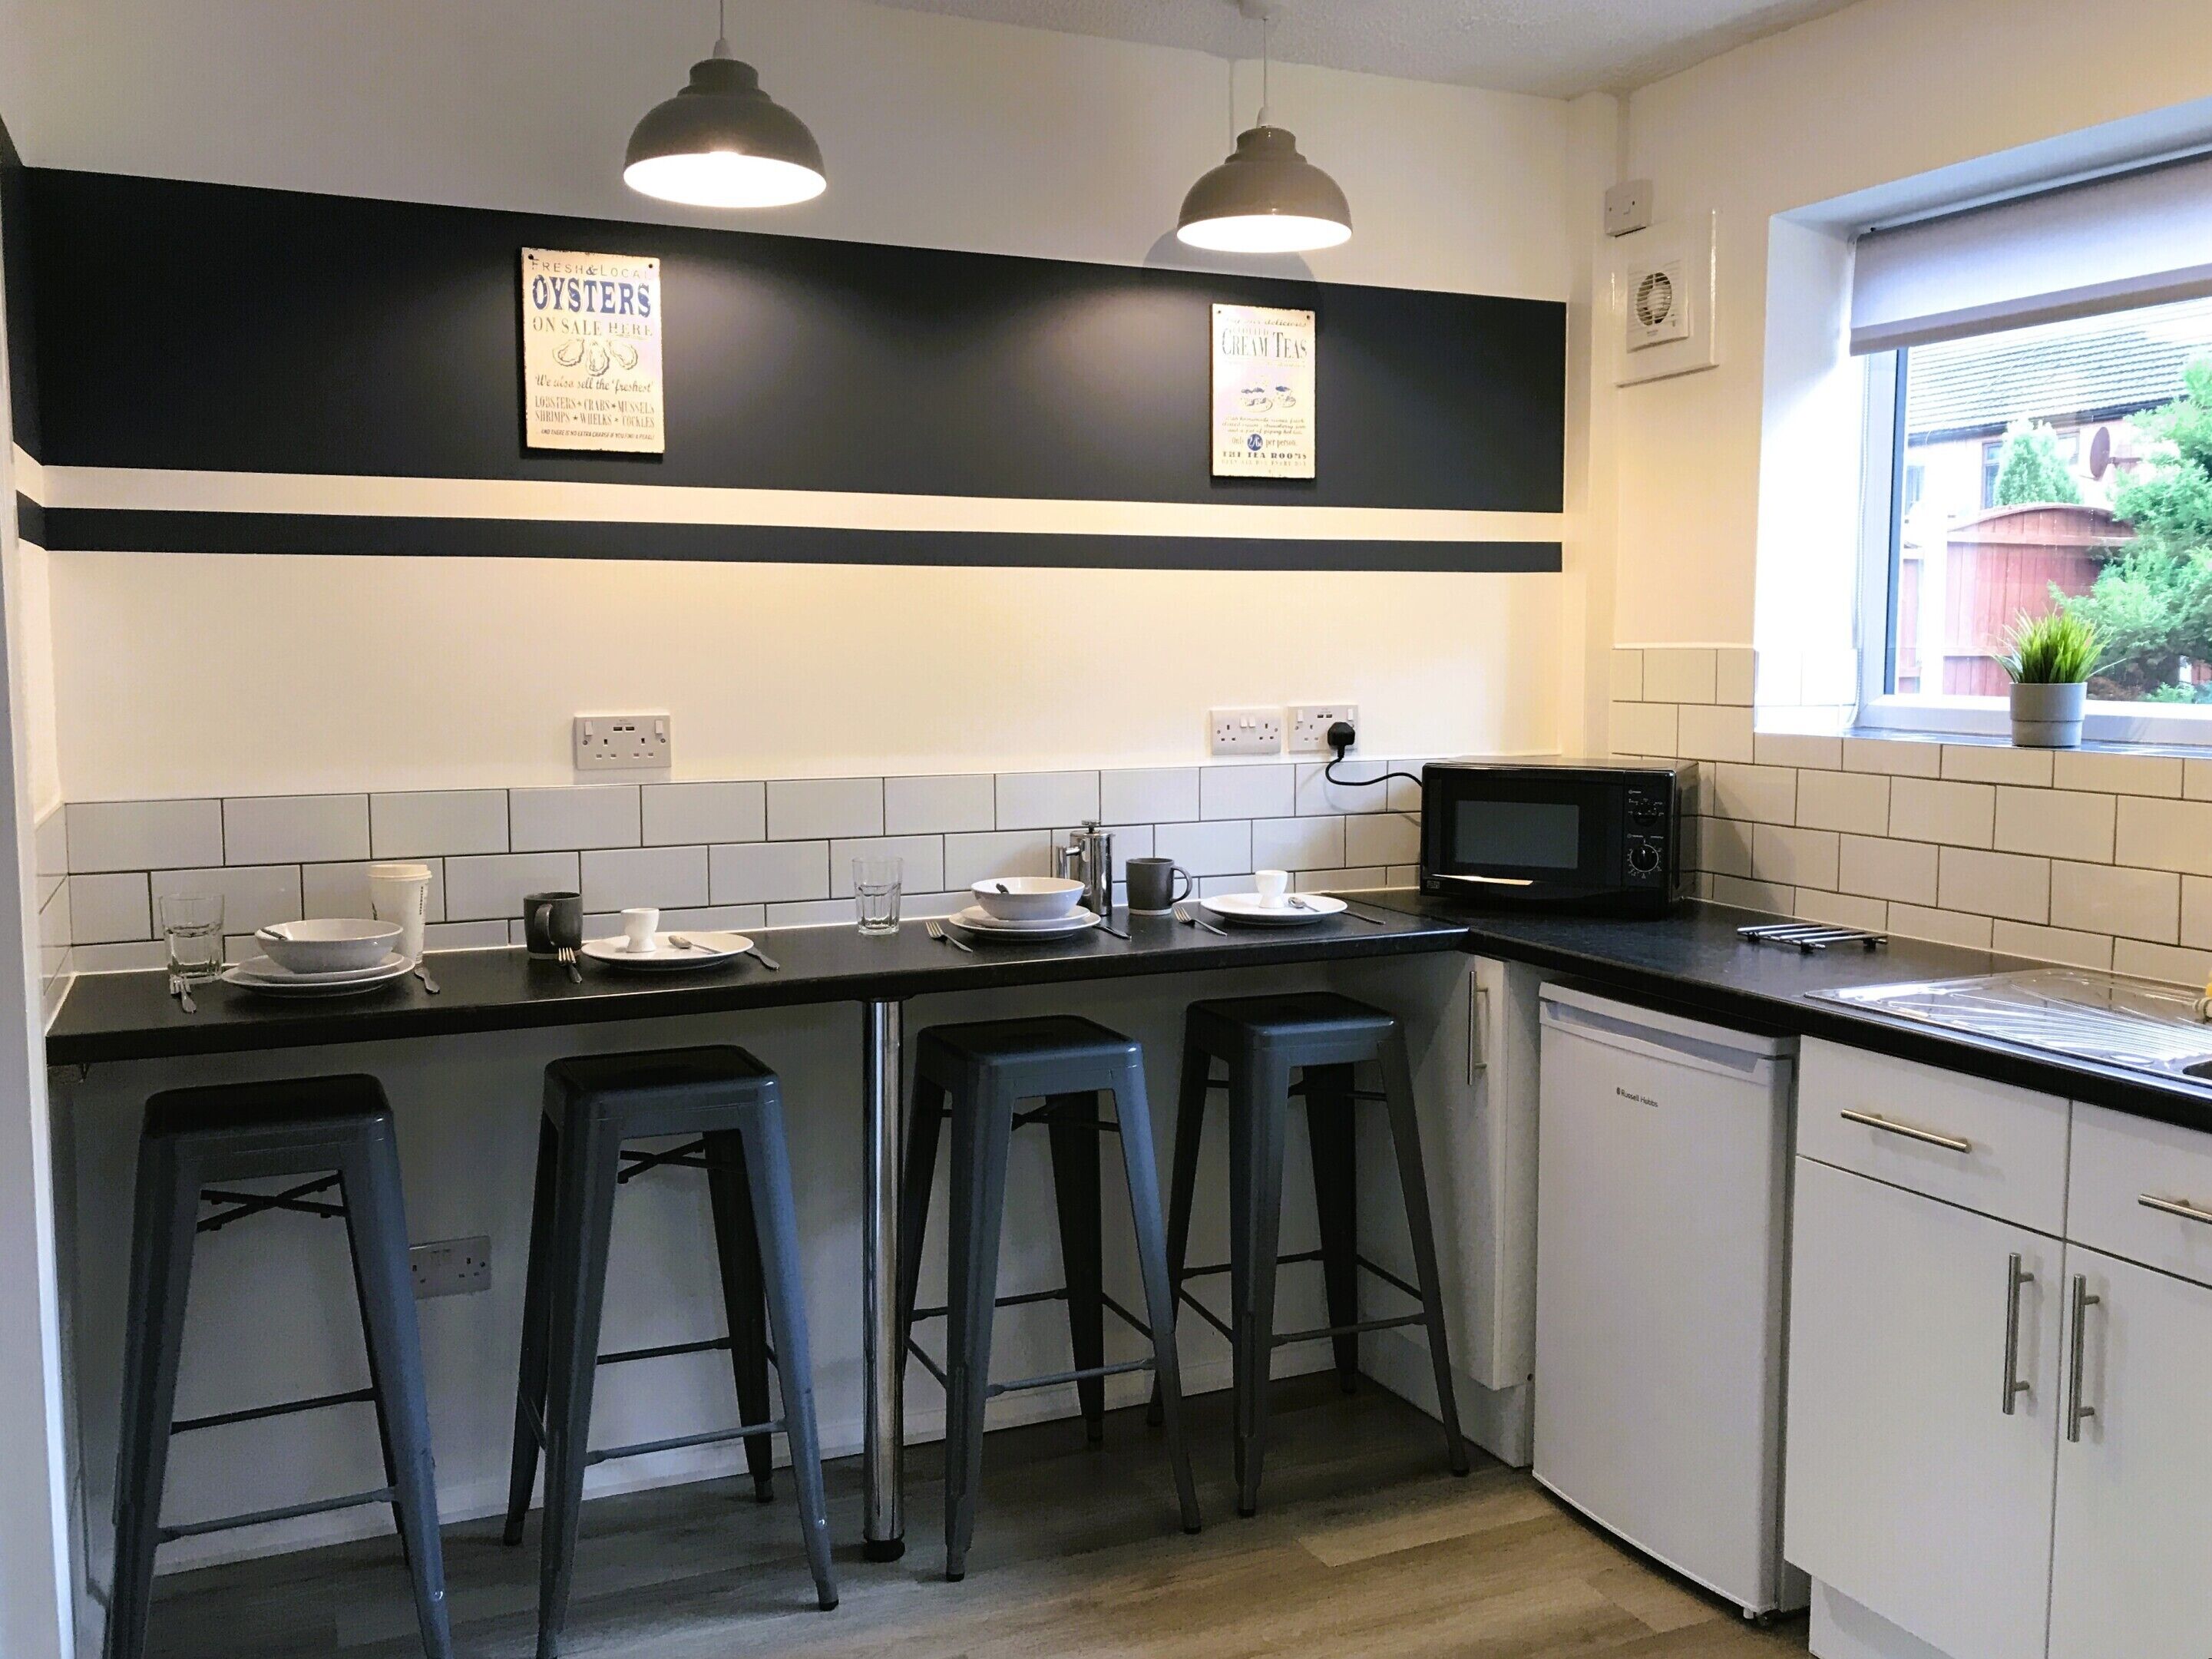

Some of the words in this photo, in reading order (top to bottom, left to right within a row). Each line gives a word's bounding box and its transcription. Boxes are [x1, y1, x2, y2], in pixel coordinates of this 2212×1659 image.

[531, 259, 584, 274] FRESH
[585, 266, 599, 276] &
[532, 273, 652, 319] OYSTERS
[533, 316, 556, 332] ON
[561, 318, 603, 336] SALE
[608, 322, 653, 337] HERE
[1272, 332, 1308, 359] TEAS
[535, 374, 551, 388] We
[577, 377, 594, 390] sell
[596, 378, 610, 392] the
[534, 395, 577, 410] LOBSTERS
[584, 398, 611, 411] CRABS
[617, 400, 656, 415] MUSSELS
[534, 409, 570, 423] SHRIMPS
[580, 412, 613, 427] WHELKS
[622, 415, 656, 428] COCKLES
